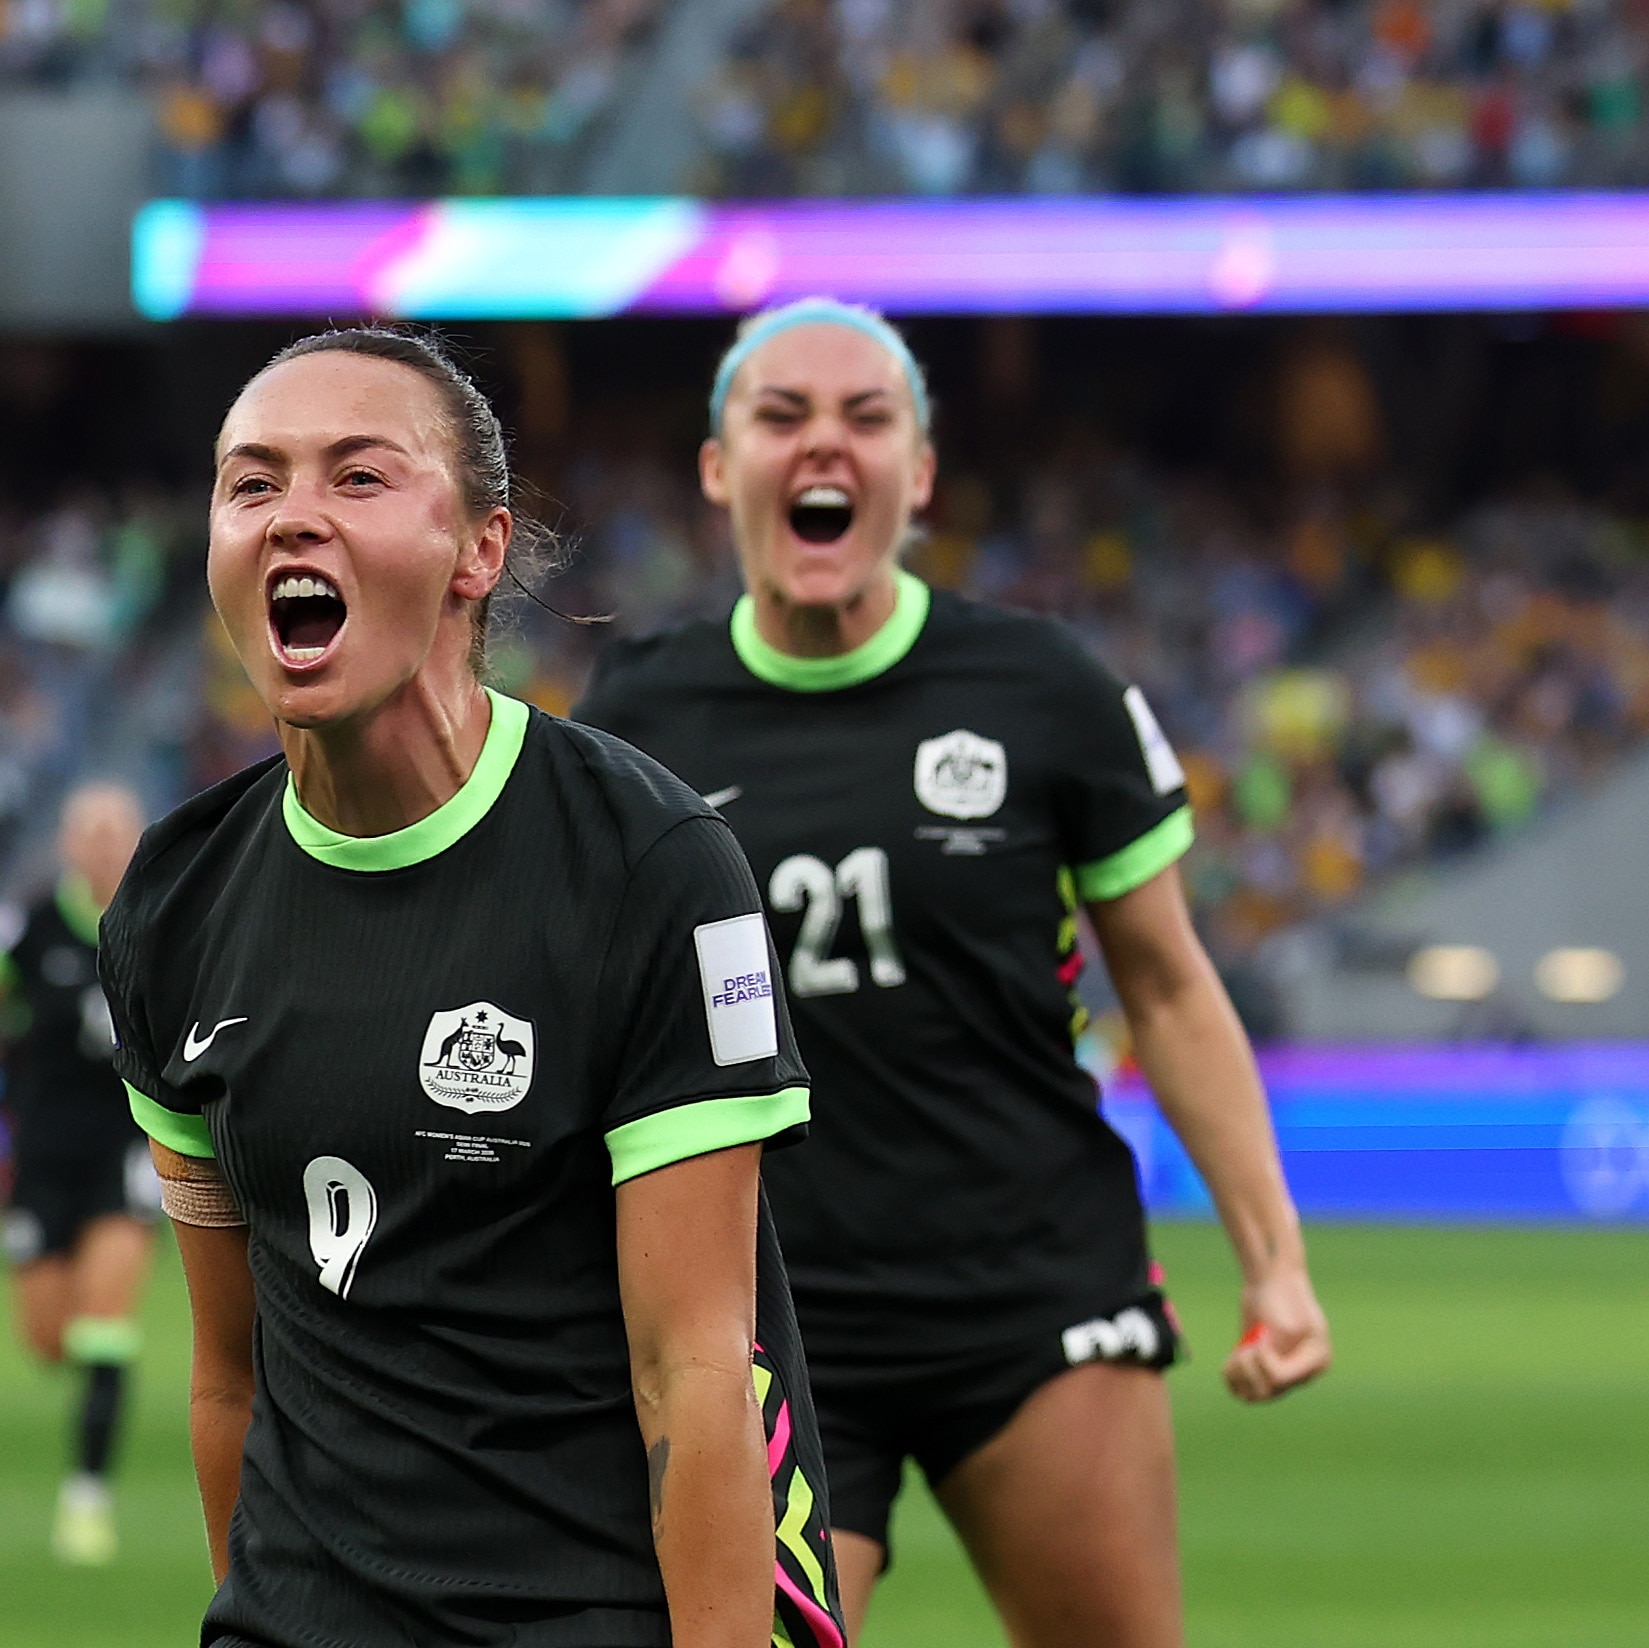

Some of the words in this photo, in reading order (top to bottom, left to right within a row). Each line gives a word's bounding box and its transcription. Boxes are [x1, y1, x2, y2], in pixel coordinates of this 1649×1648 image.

[768, 847, 906, 998] 21
[435, 1070, 512, 1087] AUSTRALIA
[303, 1156, 379, 1301] 9
